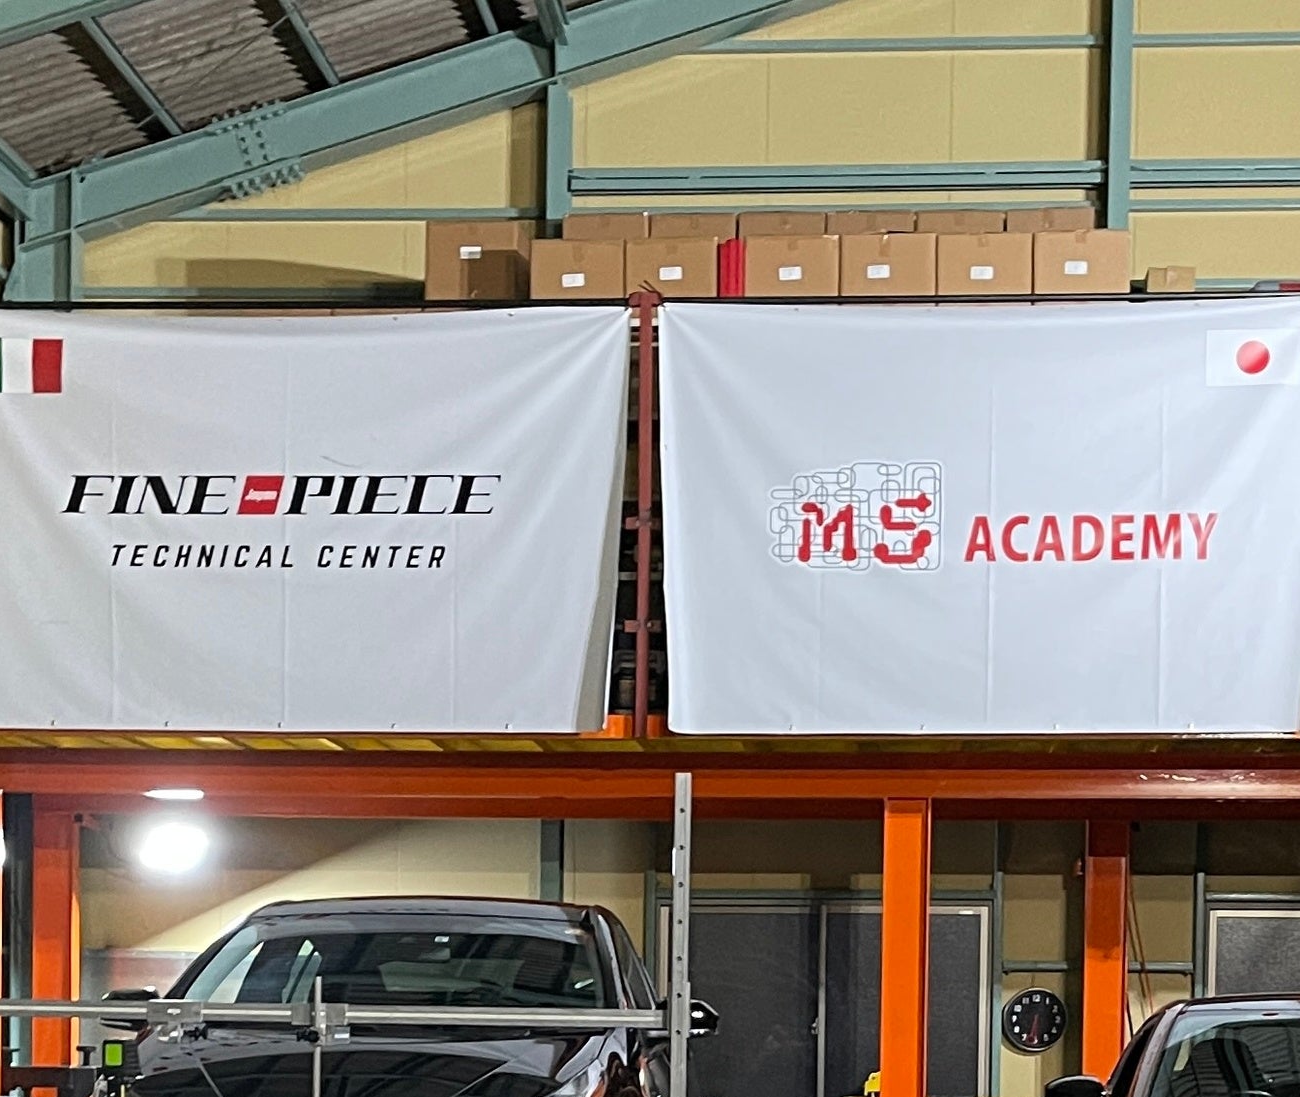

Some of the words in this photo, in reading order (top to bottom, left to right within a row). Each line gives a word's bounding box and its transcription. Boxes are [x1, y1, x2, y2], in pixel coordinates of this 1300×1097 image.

[60, 474, 236, 516] FINE
[282, 474, 502, 516] PIECE
[798, 492, 932, 564] MS
[964, 512, 1220, 563] ACADEMY
[110, 544, 294, 568] TECHNICAL
[317, 545, 447, 569] CENTER
